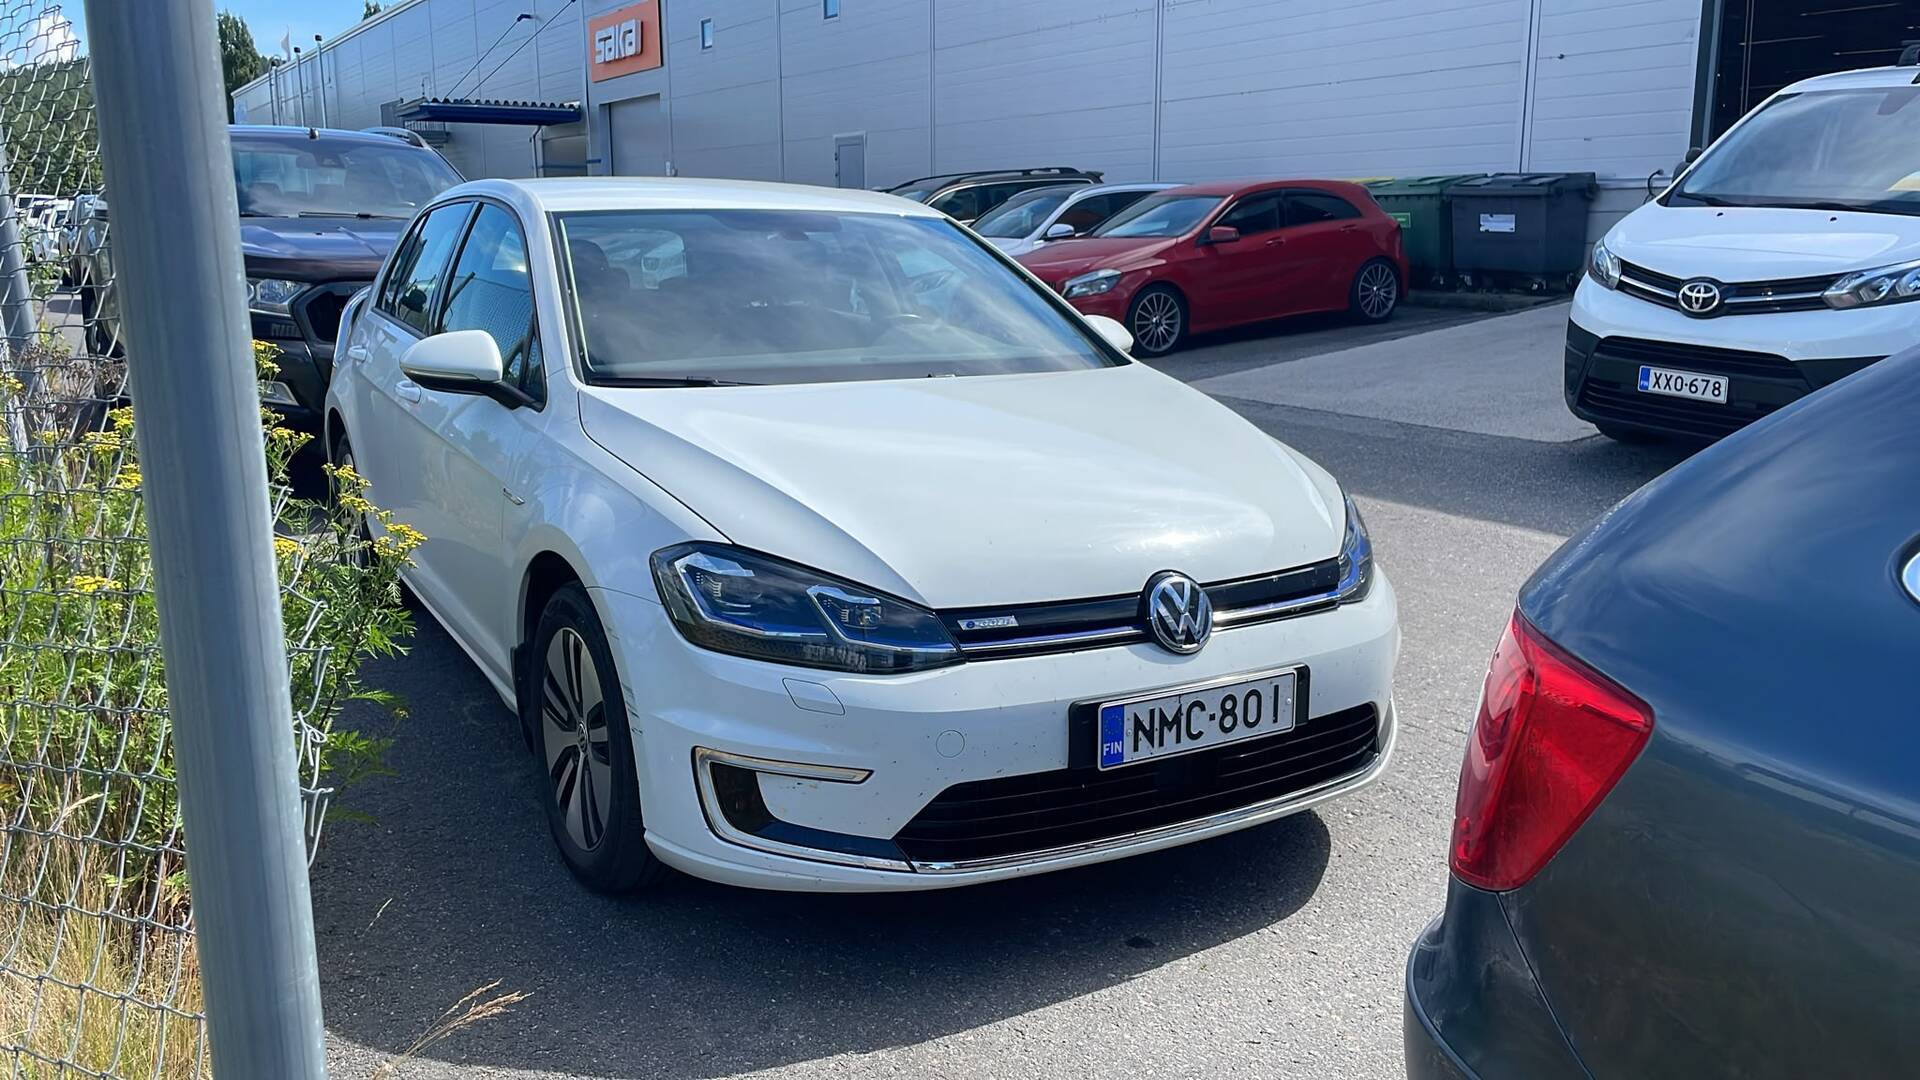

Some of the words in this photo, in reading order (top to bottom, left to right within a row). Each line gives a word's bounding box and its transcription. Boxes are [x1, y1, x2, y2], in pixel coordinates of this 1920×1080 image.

[1652, 371, 1722, 398] XXO-678
[1133, 684, 1280, 753] NMC-801
[1103, 740, 1123, 757] FIN
